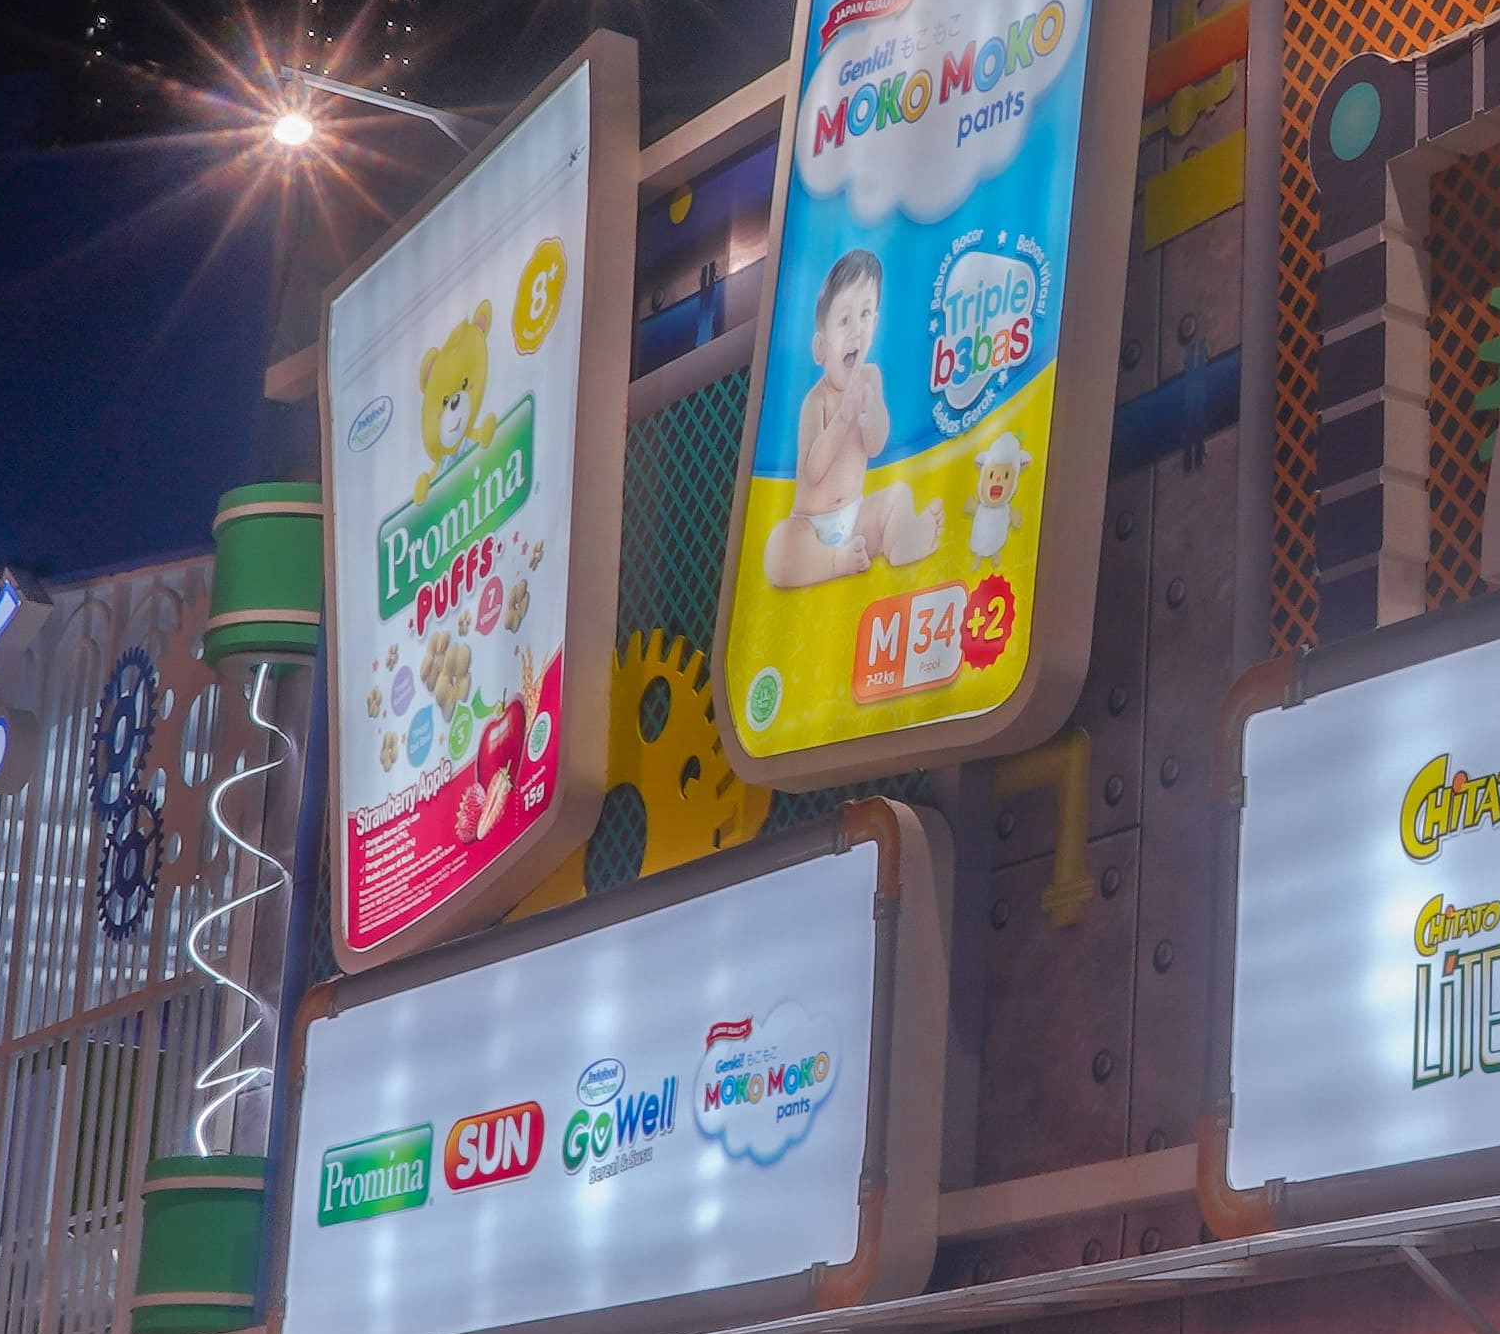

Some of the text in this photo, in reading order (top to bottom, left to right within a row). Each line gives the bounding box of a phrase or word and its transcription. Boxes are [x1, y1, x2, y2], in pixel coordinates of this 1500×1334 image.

[834, 1, 863, 24] JAPAN
[813, 0, 1066, 158] MOKO MOKO
[838, 38, 897, 87] Genki!
[956, 90, 1025, 149] pants
[945, 268, 1030, 337] Triple
[933, 316, 1031, 388] b3bas
[383, 448, 525, 601] Promina
[416, 534, 495, 638] PUFFS
[868, 595, 1007, 667] M 34 +2
[355, 783, 417, 837] Strawberry
[417, 757, 453, 803] Apple
[522, 781, 546, 812] 15g
[703, 1051, 831, 1112] MOKO MOKO
[776, 1097, 811, 1123] pants
[453, 1111, 534, 1179] SUN
[322, 1148, 425, 1214] Promina
